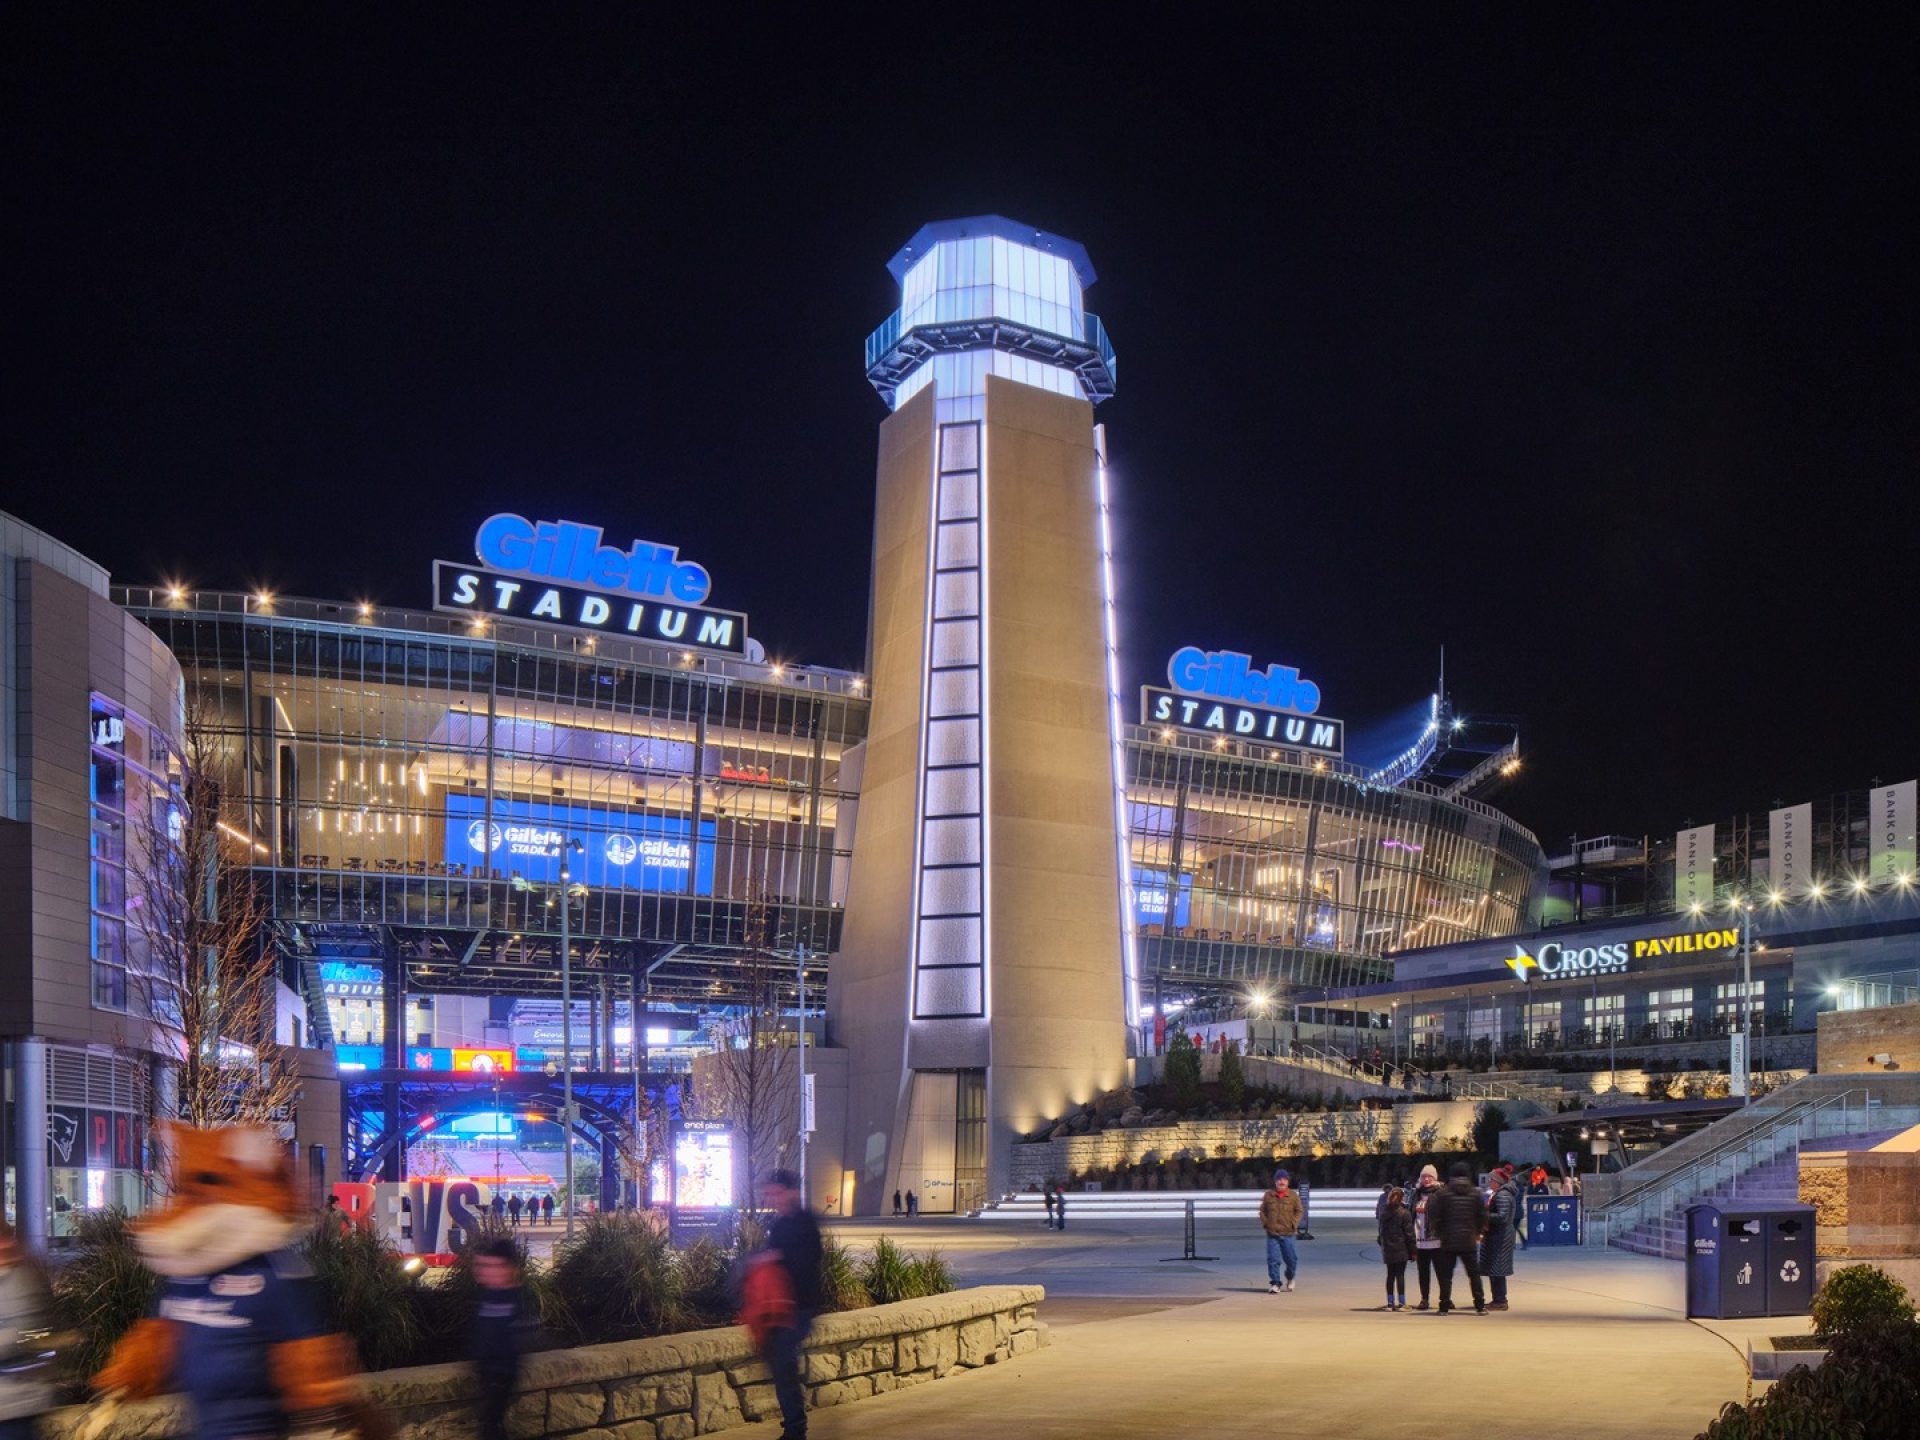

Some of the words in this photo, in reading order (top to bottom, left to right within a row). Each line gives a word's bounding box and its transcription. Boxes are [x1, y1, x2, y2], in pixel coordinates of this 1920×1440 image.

[476, 513, 711, 604] Gillette
[453, 575, 733, 645] STADIUM
[1168, 647, 1319, 714] Gillette
[1155, 696, 1335, 748] STADIUM
[1886, 790, 1896, 829] BANK
[1687, 832, 1697, 867] BANK
[1783, 812, 1793, 849] BANK
[1886, 832, 1896, 850] OF
[1687, 871, 1696, 886] OF
[1783, 852, 1793, 869] OF
[1538, 943, 1629, 974] CROSS
[1635, 928, 1740, 958] PAVILION
[324, 983, 384, 995] ADIU
[1542, 965, 1627, 980] INSURANCE
[333, 1182, 486, 1254] REVS
